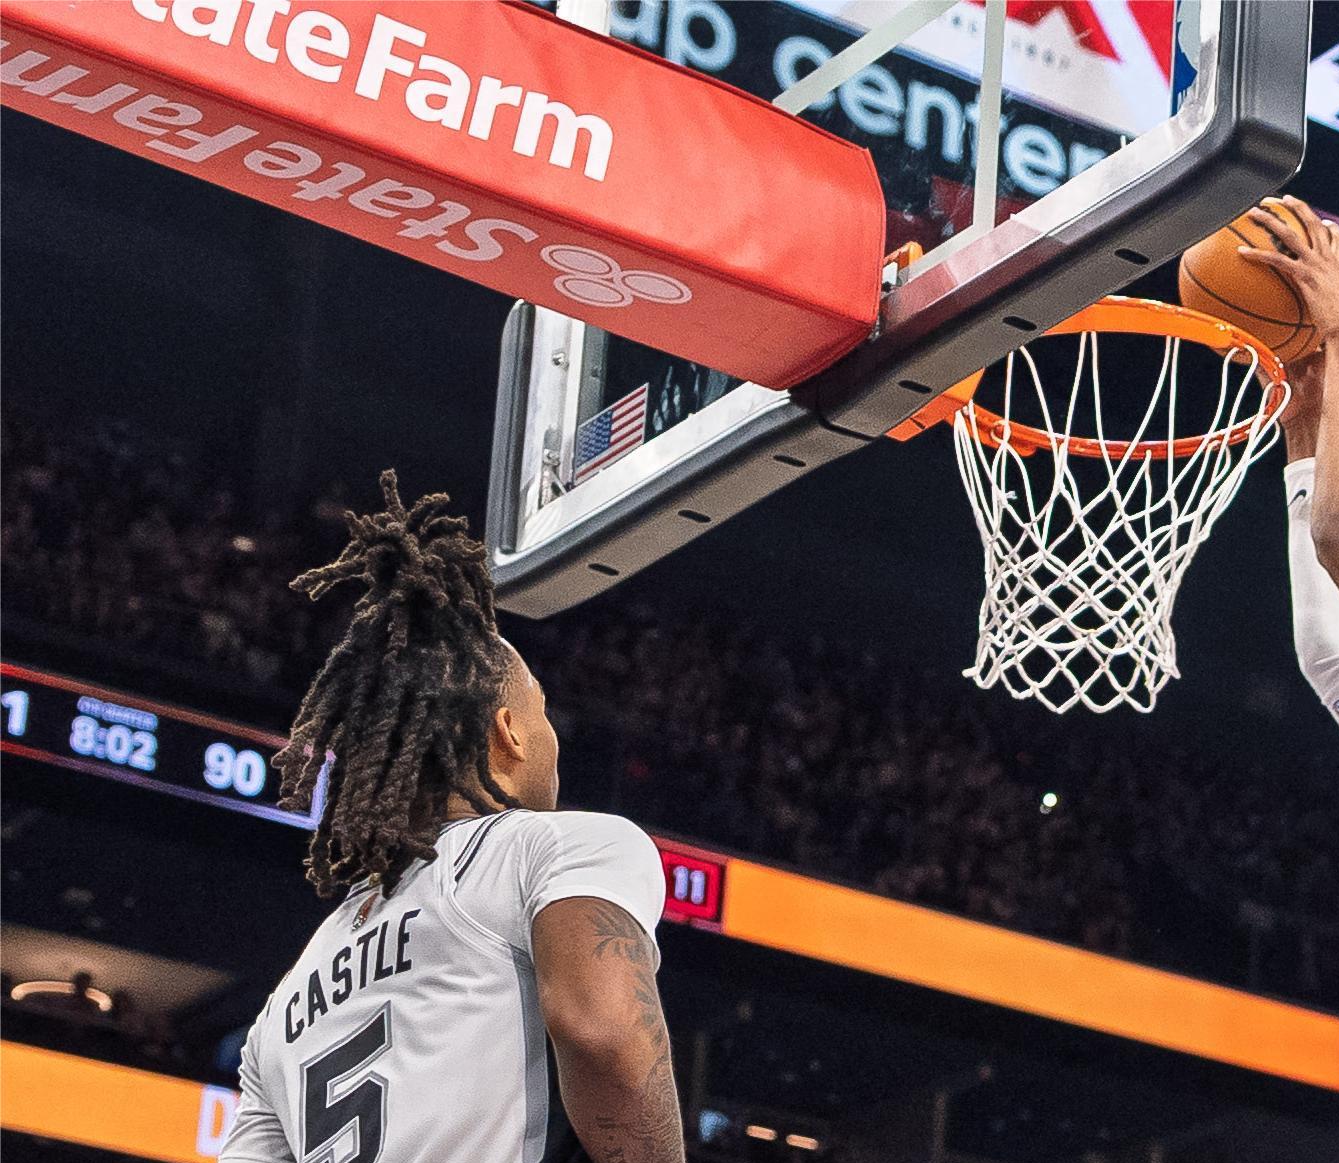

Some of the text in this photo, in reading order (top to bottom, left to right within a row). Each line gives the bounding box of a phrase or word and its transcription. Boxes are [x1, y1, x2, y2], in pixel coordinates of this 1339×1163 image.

[130, 0, 351, 83] ate
[1, 690, 30, 736] 1
[69, 715, 158, 771] 8:02
[203, 742, 266, 797] 90
[673, 865, 706, 905] 11
[285, 908, 421, 1045] CASTLE
